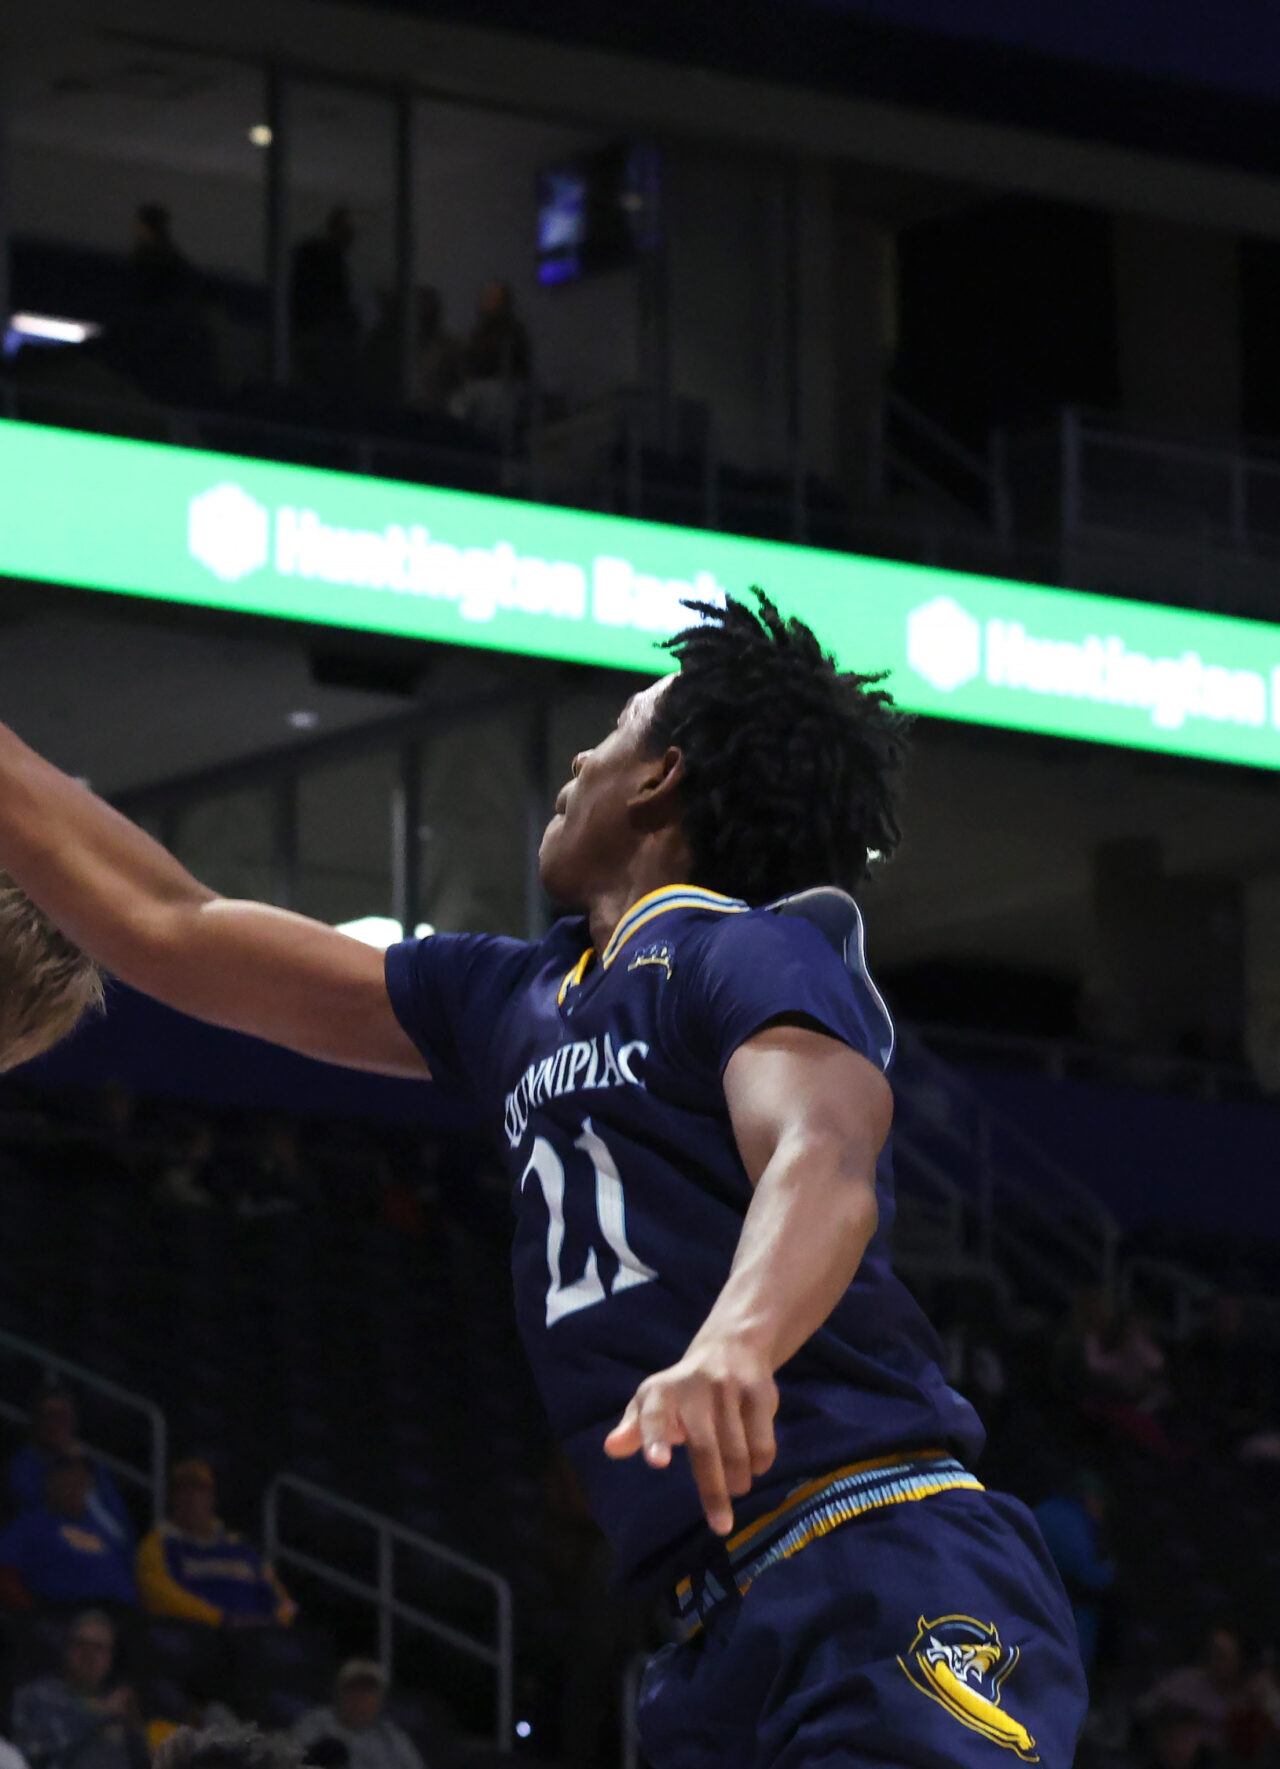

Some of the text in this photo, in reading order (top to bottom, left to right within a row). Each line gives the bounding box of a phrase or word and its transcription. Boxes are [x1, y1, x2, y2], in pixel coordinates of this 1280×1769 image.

[276, 506, 586, 622] Huntington
[986, 619, 1265, 728] Huntington
[521, 1116, 659, 1329] 21
